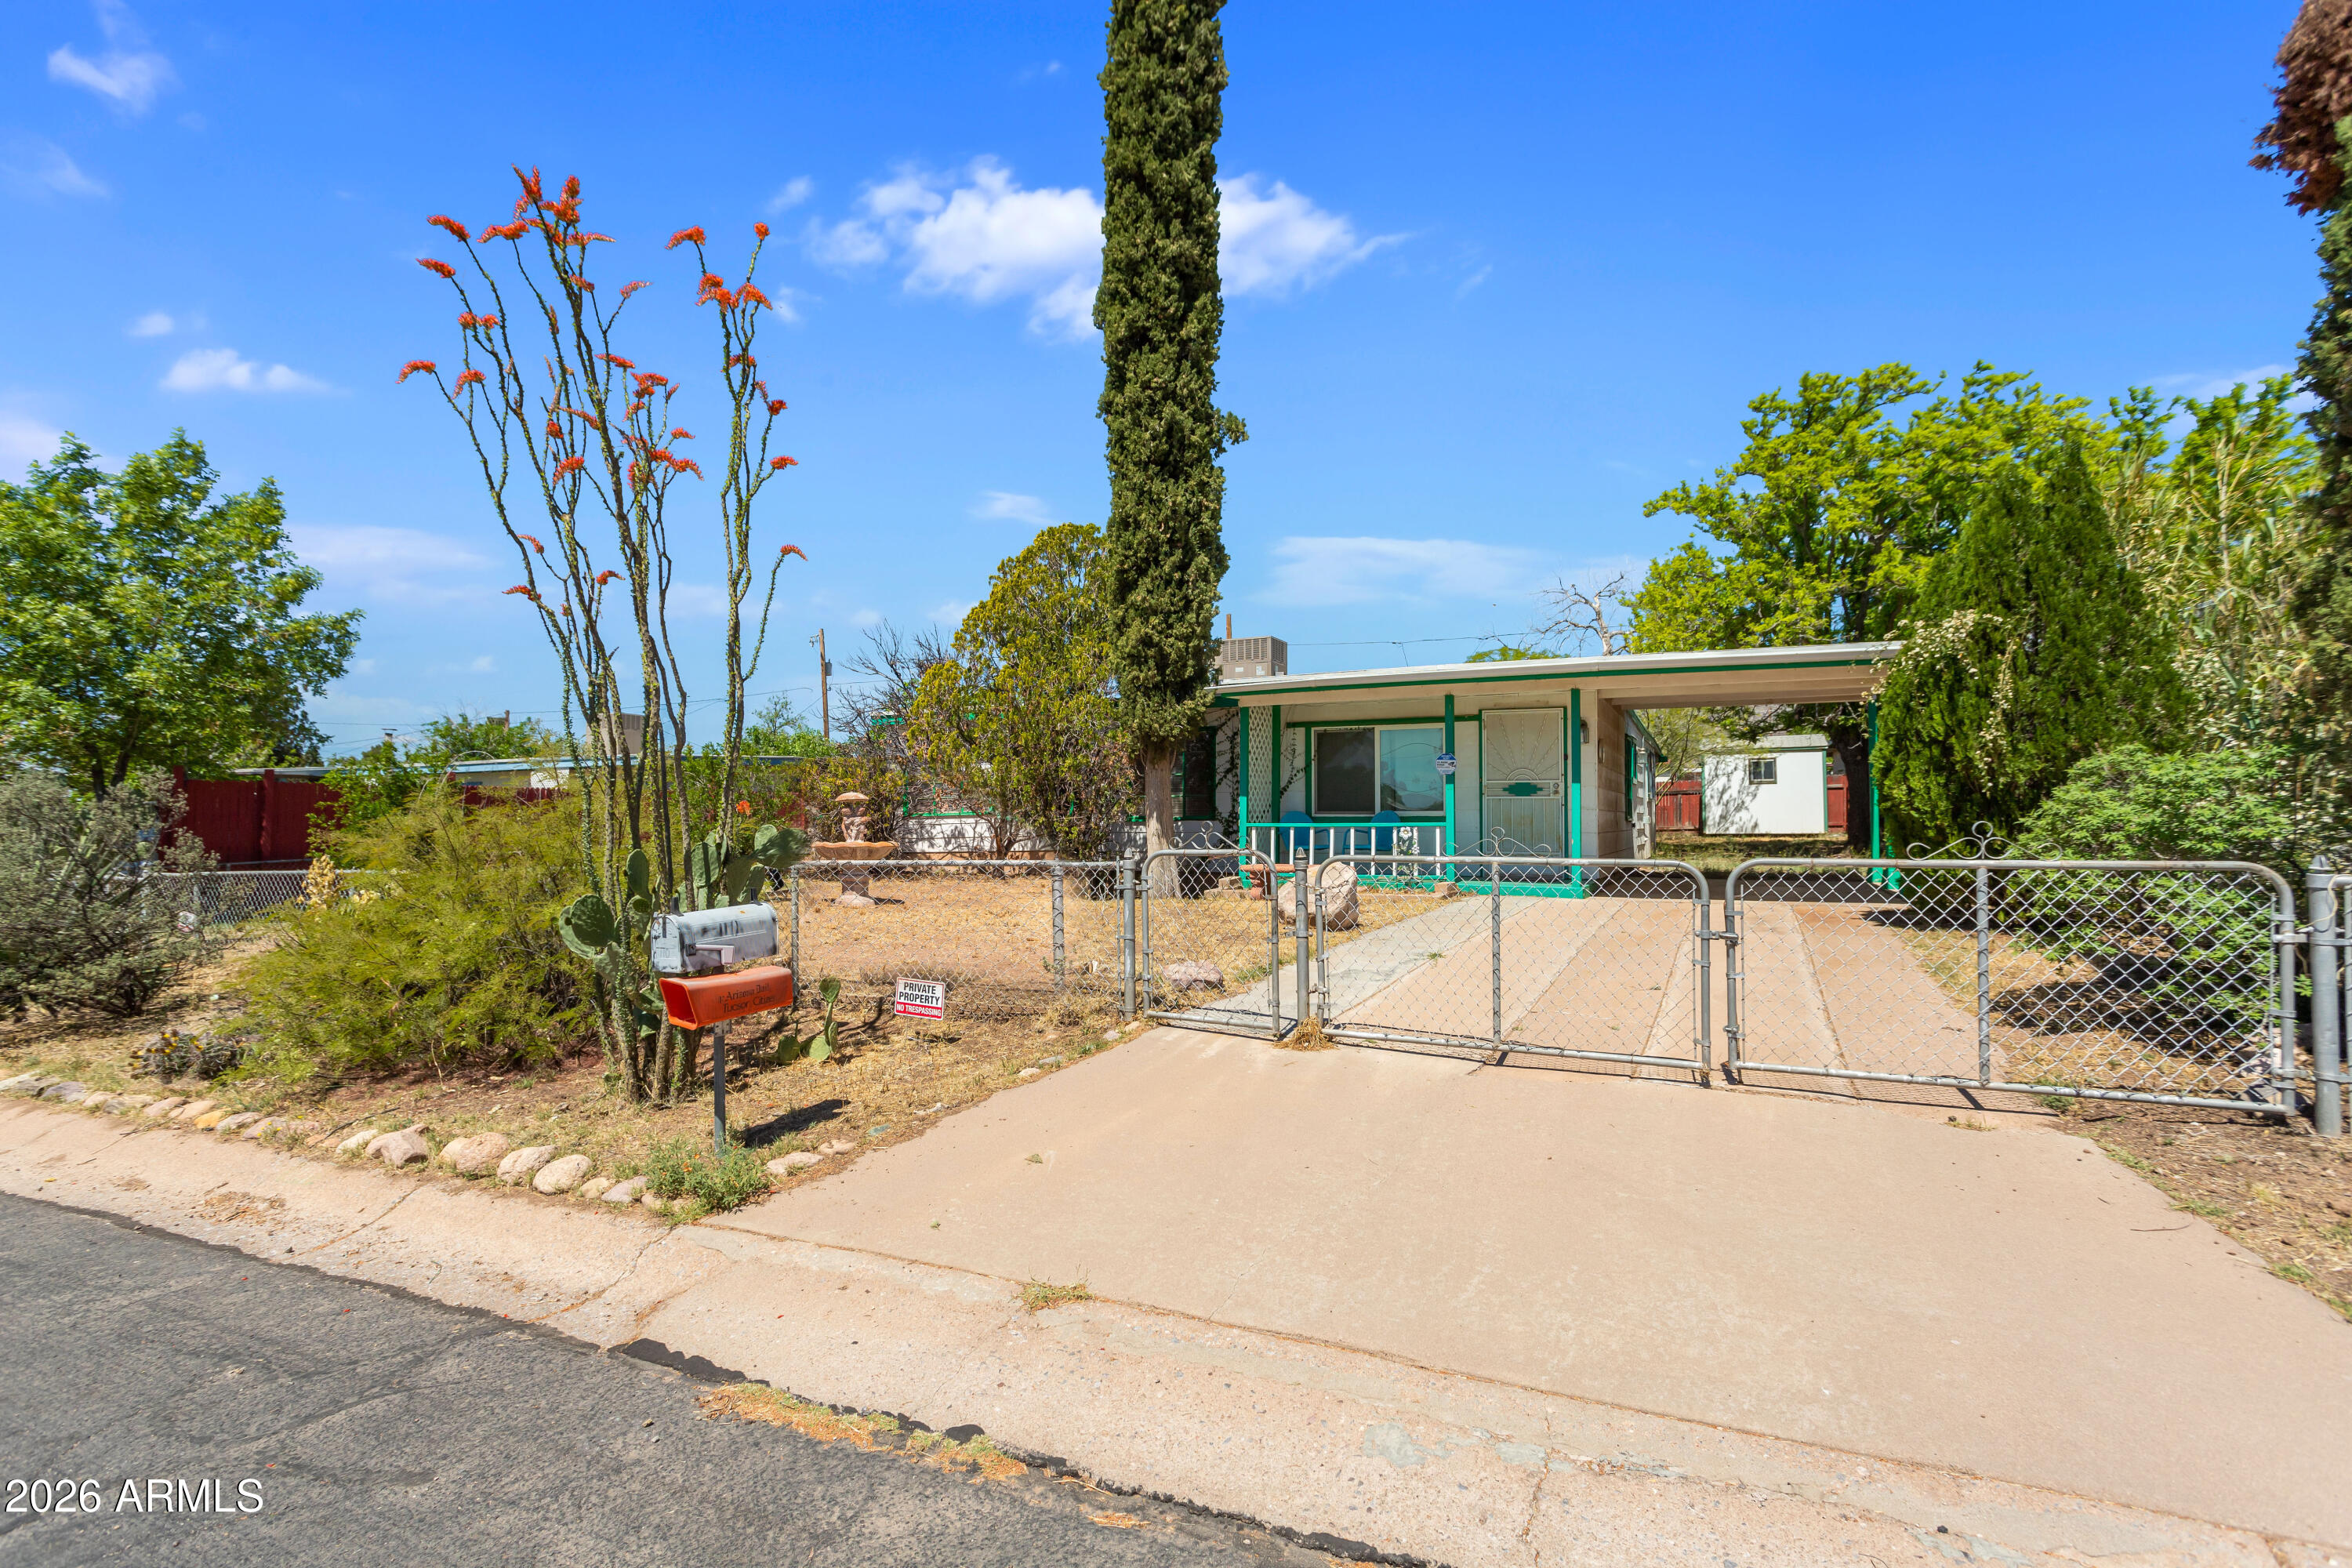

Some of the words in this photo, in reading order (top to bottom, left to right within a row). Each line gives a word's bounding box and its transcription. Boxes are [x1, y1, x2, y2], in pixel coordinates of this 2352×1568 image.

[904, 982, 936, 994] PRIVATE
[899, 992, 940, 1005] PROPERTY
[906, 1005, 941, 1016] TRESPASSING
